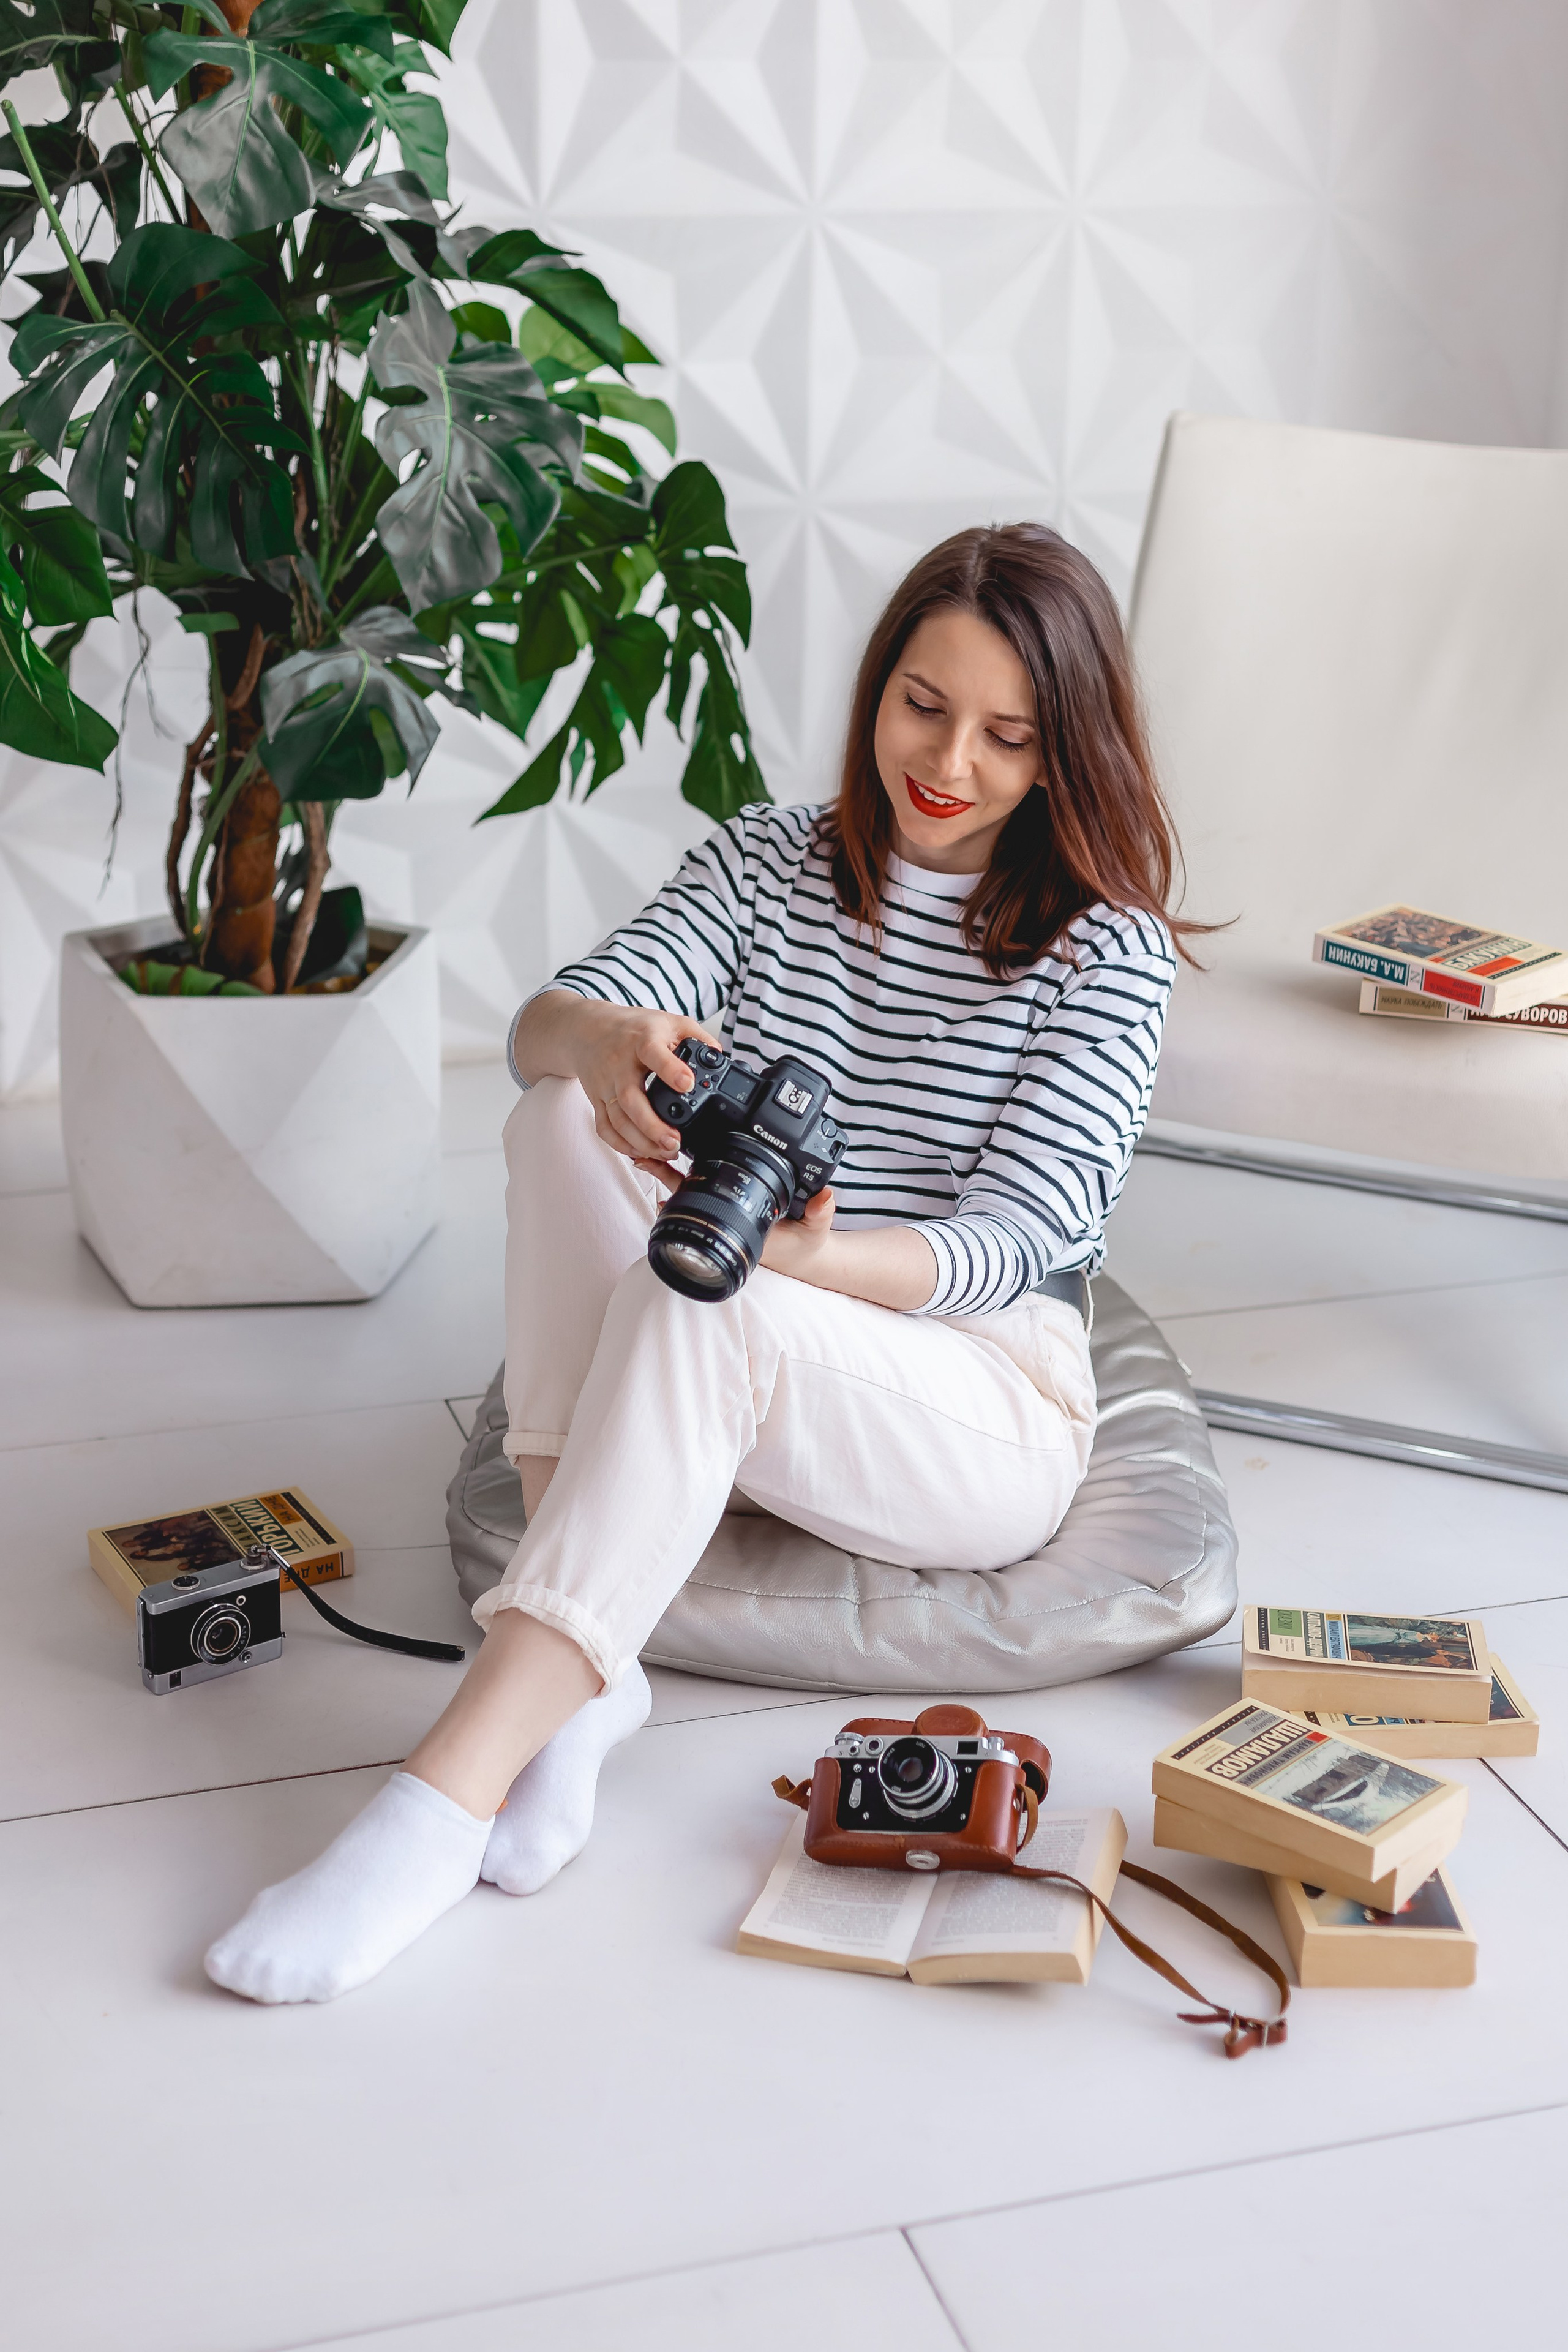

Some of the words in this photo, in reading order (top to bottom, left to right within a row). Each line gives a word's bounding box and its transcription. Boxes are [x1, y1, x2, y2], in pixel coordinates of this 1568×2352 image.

[1328, 946, 1378, 972] БАКУНИН
[1445, 939, 1529, 969] БАКУНИН
[1379, 959, 1405, 980] М.А.
[1381, 996, 1402, 1005] НАУКА
[753, 1124, 788, 1151] Canon
[803, 1172, 814, 1181] R5
[805, 1163, 822, 1174] EOS
[278, 1511, 294, 1521] НА
[284, 1566, 309, 1583] ДЕ
[316, 1561, 333, 1576] НА
[1277, 1610, 1292, 1629] СКАЗКИ
[1211, 1721, 1308, 1777] ШАЛАМОВ
[1280, 1739, 1314, 1759] ВАРЛАМ
[1239, 1758, 1286, 1784] ТИХОНОВИЧ
